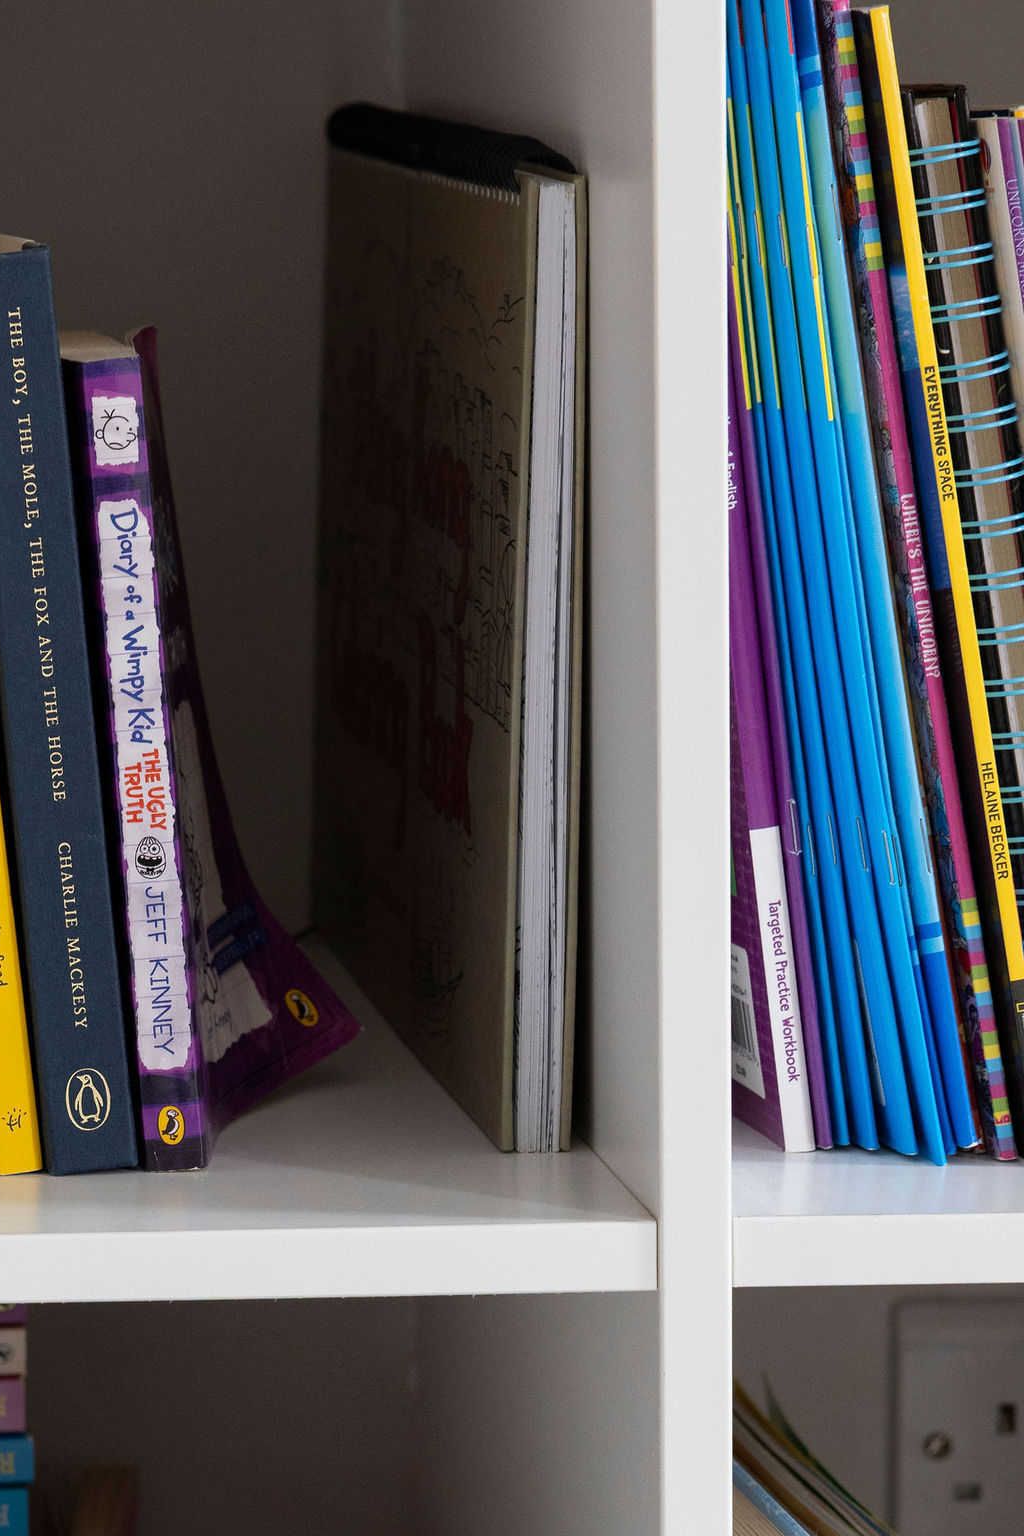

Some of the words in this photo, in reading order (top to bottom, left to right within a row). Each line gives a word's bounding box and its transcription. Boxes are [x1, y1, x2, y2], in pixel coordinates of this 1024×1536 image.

[8, 306, 23, 347] THE
[12, 357, 27, 404] BOY,
[18, 413, 33, 454] THE
[924, 366, 946, 455] EVERYTHING
[938, 460, 954, 501] SPACE
[22, 464, 39, 528] MOLE,
[110, 508, 138, 577] Diary
[898, 492, 923, 558] WHERE'S
[29, 537, 44, 577] THE
[909, 563, 928, 593] THE
[34, 587, 49, 625] FOX
[123, 584, 142, 603] of
[125, 609, 134, 620] a
[38, 636, 53, 677] AND
[120, 625, 147, 701] Wimpy
[914, 599, 942, 679] UNICORN?
[43, 686, 58, 726] THE
[127, 707, 157, 745] Kid
[48, 736, 65, 800] HORSE
[124, 762, 144, 822] TRUTH
[141, 748, 162, 783] THE
[146, 786, 166, 829] UGLY
[981, 762, 999, 821] HELAINE
[990, 825, 1008, 879] BECKER
[58, 842, 77, 927] CHARLIE
[145, 886, 166, 943] JEFF
[767, 900, 785, 955] Targeted
[67, 938, 86, 1026] MACKESY
[149, 958, 173, 1053] KINNEY
[775, 960, 790, 1010] Practice
[782, 1016, 799, 1081] Workbook
